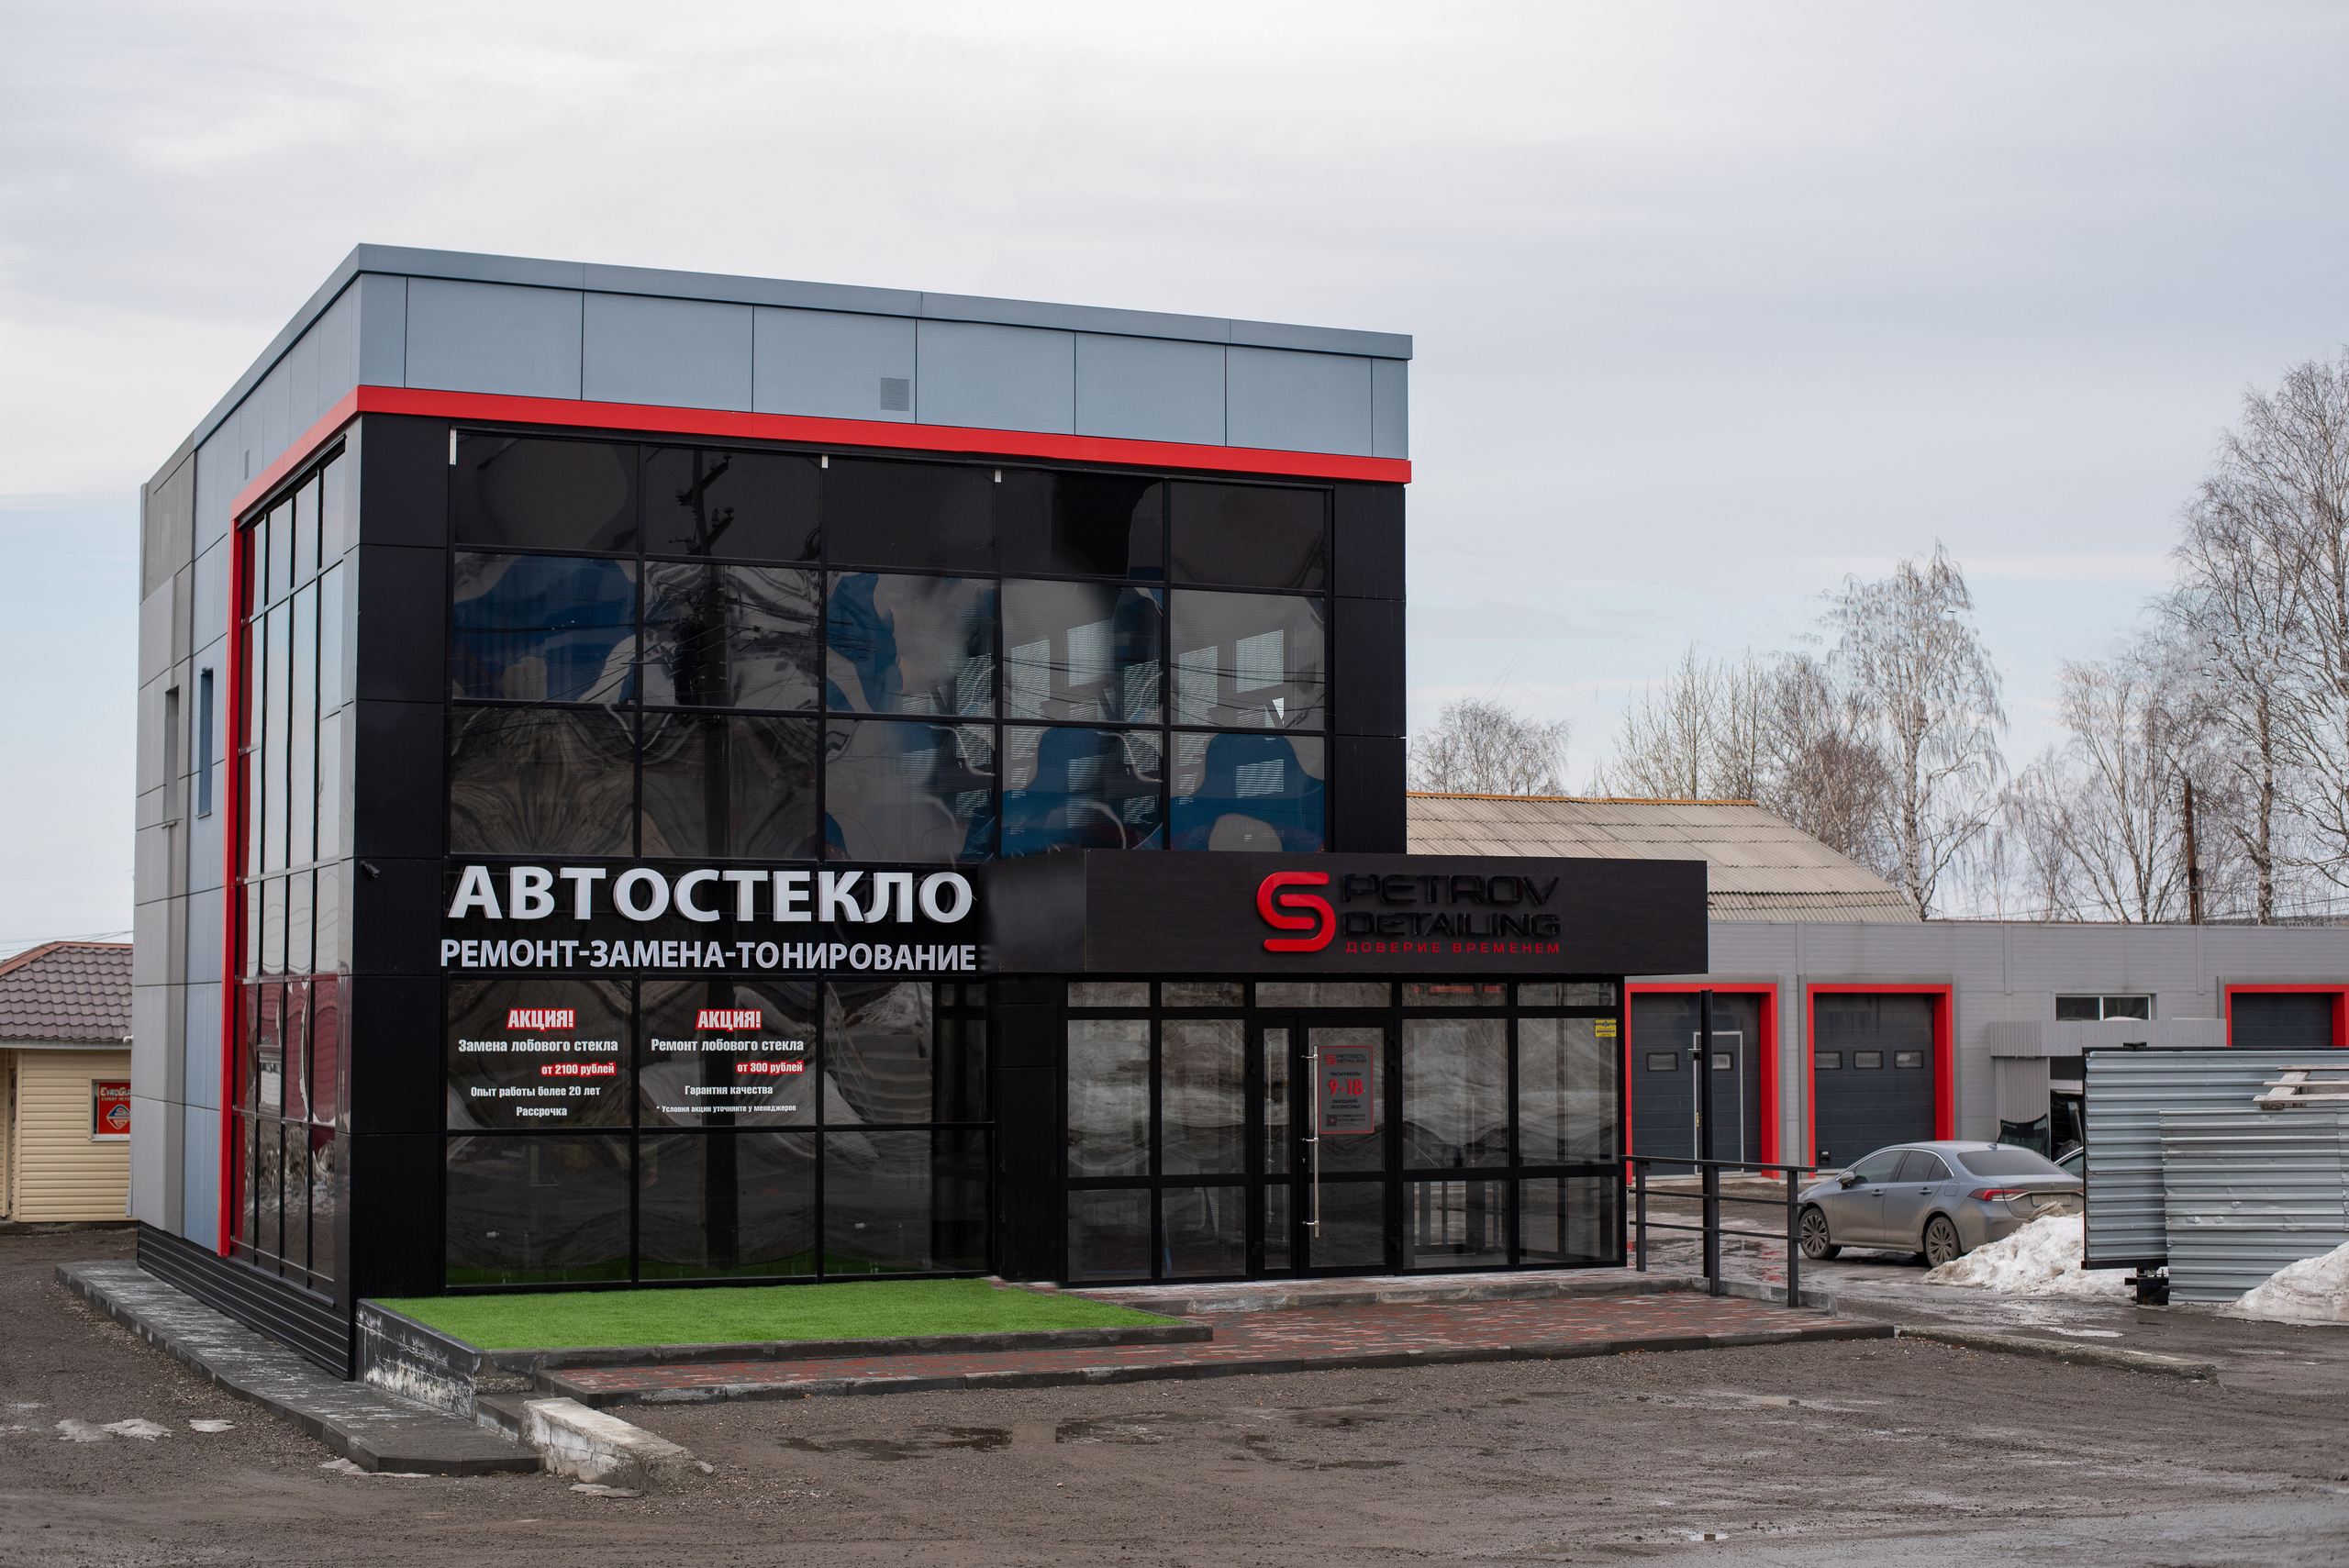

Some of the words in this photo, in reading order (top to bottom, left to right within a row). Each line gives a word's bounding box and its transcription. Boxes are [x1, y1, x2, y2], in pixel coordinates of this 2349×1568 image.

[447, 864, 973, 923] АВТОСТЕКЛО
[1343, 873, 1560, 906] PETROV
[1343, 911, 1561, 938] DETAILING
[1345, 941, 1441, 954] ДОВЕРИЕ
[1453, 942, 1559, 954] ВРЕМЕНЕМ
[440, 939, 976, 971] РЕМОНТ-ЗАМЕНА-ТОНИРОВАНИЕ
[507, 1009, 575, 1030] АКЦИЯ!
[697, 1010, 762, 1031] АКЦИЯ!
[458, 1039, 508, 1052] Замена
[511, 1039, 571, 1052] лобового
[573, 1040, 618, 1051] стекла
[651, 1039, 698, 1051] Ремонт
[700, 1039, 759, 1051] лобового
[761, 1040, 805, 1051] стекла
[541, 1066, 552, 1075] от
[554, 1064, 578, 1074] 2100
[580, 1062, 615, 1076] рублей
[737, 1063, 749, 1073] от
[750, 1062, 768, 1073] 300
[770, 1062, 803, 1073] рублей
[471, 1086, 497, 1097] Опыт
[498, 1086, 536, 1098] работы
[538, 1086, 567, 1096] более
[569, 1085, 582, 1096] 20
[584, 1086, 601, 1096] лет
[685, 1085, 728, 1096] Гарантия
[729, 1085, 774, 1095] качества
[516, 1106, 567, 1118] Рассрочка
[662, 1105, 690, 1113] Условия
[753, 1105, 796, 1113] менеджеров
